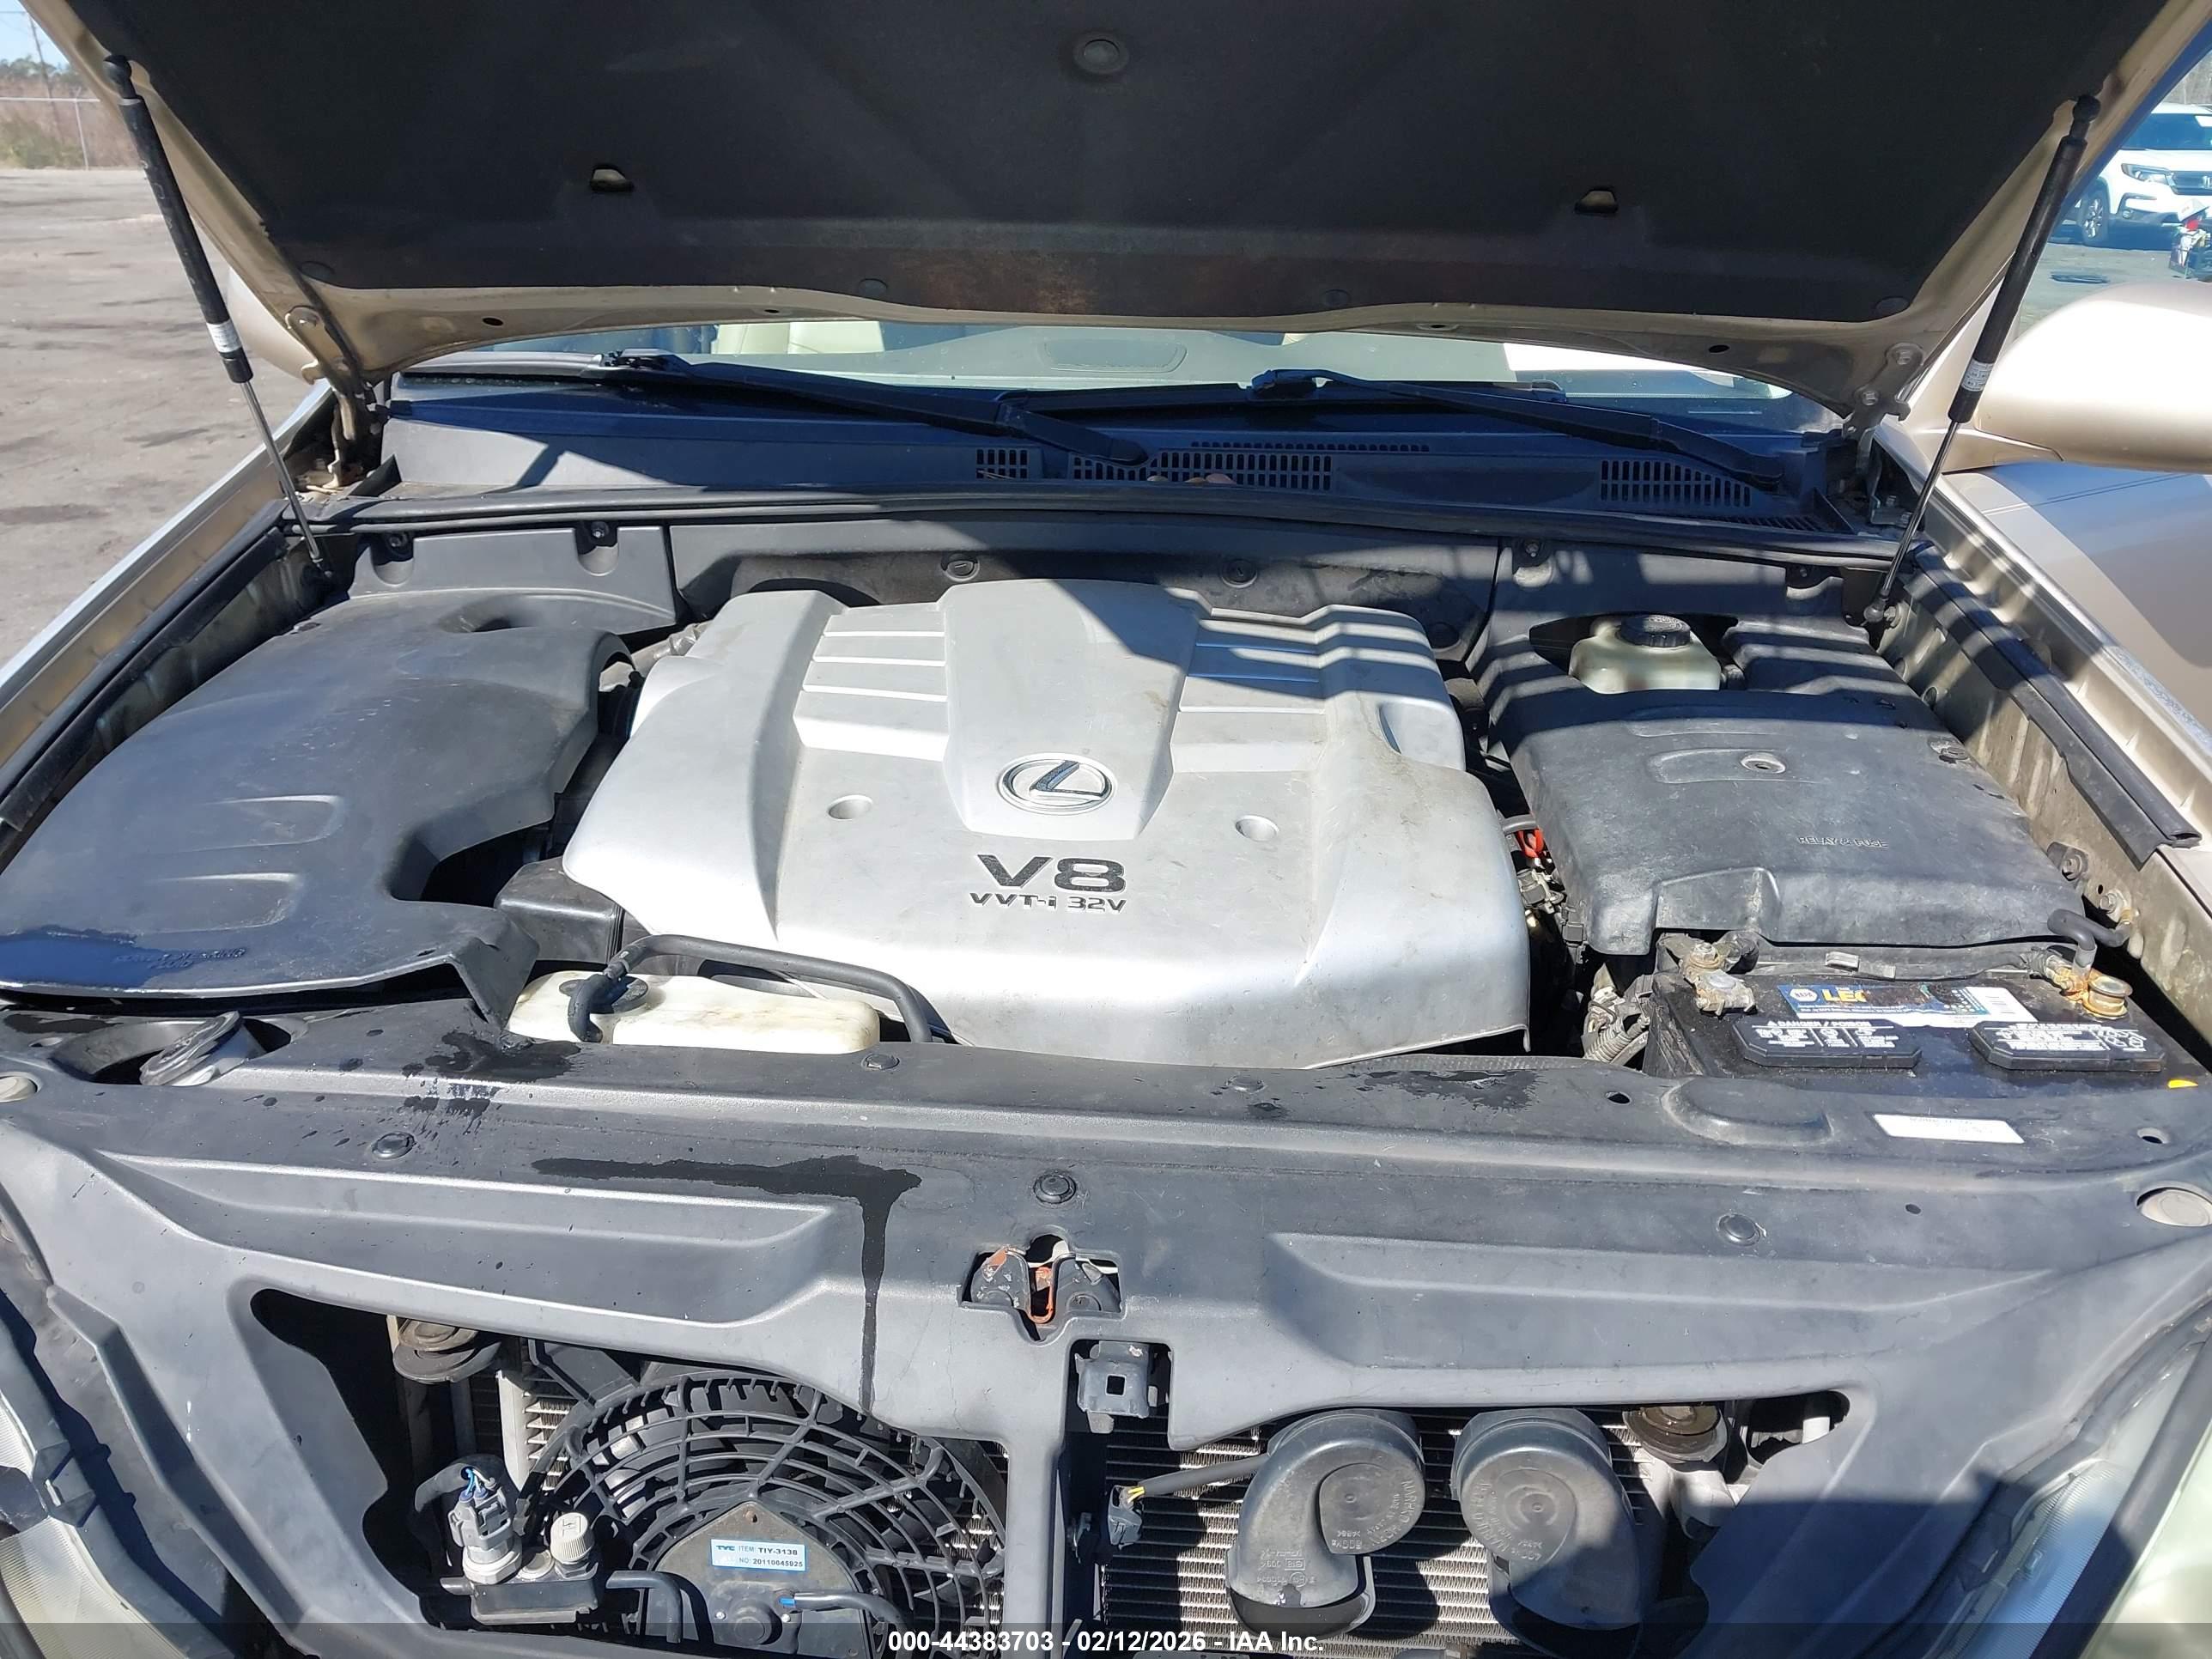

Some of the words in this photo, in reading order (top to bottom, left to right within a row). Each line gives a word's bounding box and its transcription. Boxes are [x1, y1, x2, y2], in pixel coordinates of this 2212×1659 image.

[1797, 836, 1838, 846] RELAY
[1854, 837, 1889, 848] FUSE
[977, 854, 1126, 893] V8
[969, 892, 1057, 910] VVT-i
[1067, 896, 1127, 913] 32V
[757, 1547, 798, 1556] TIY-3138
